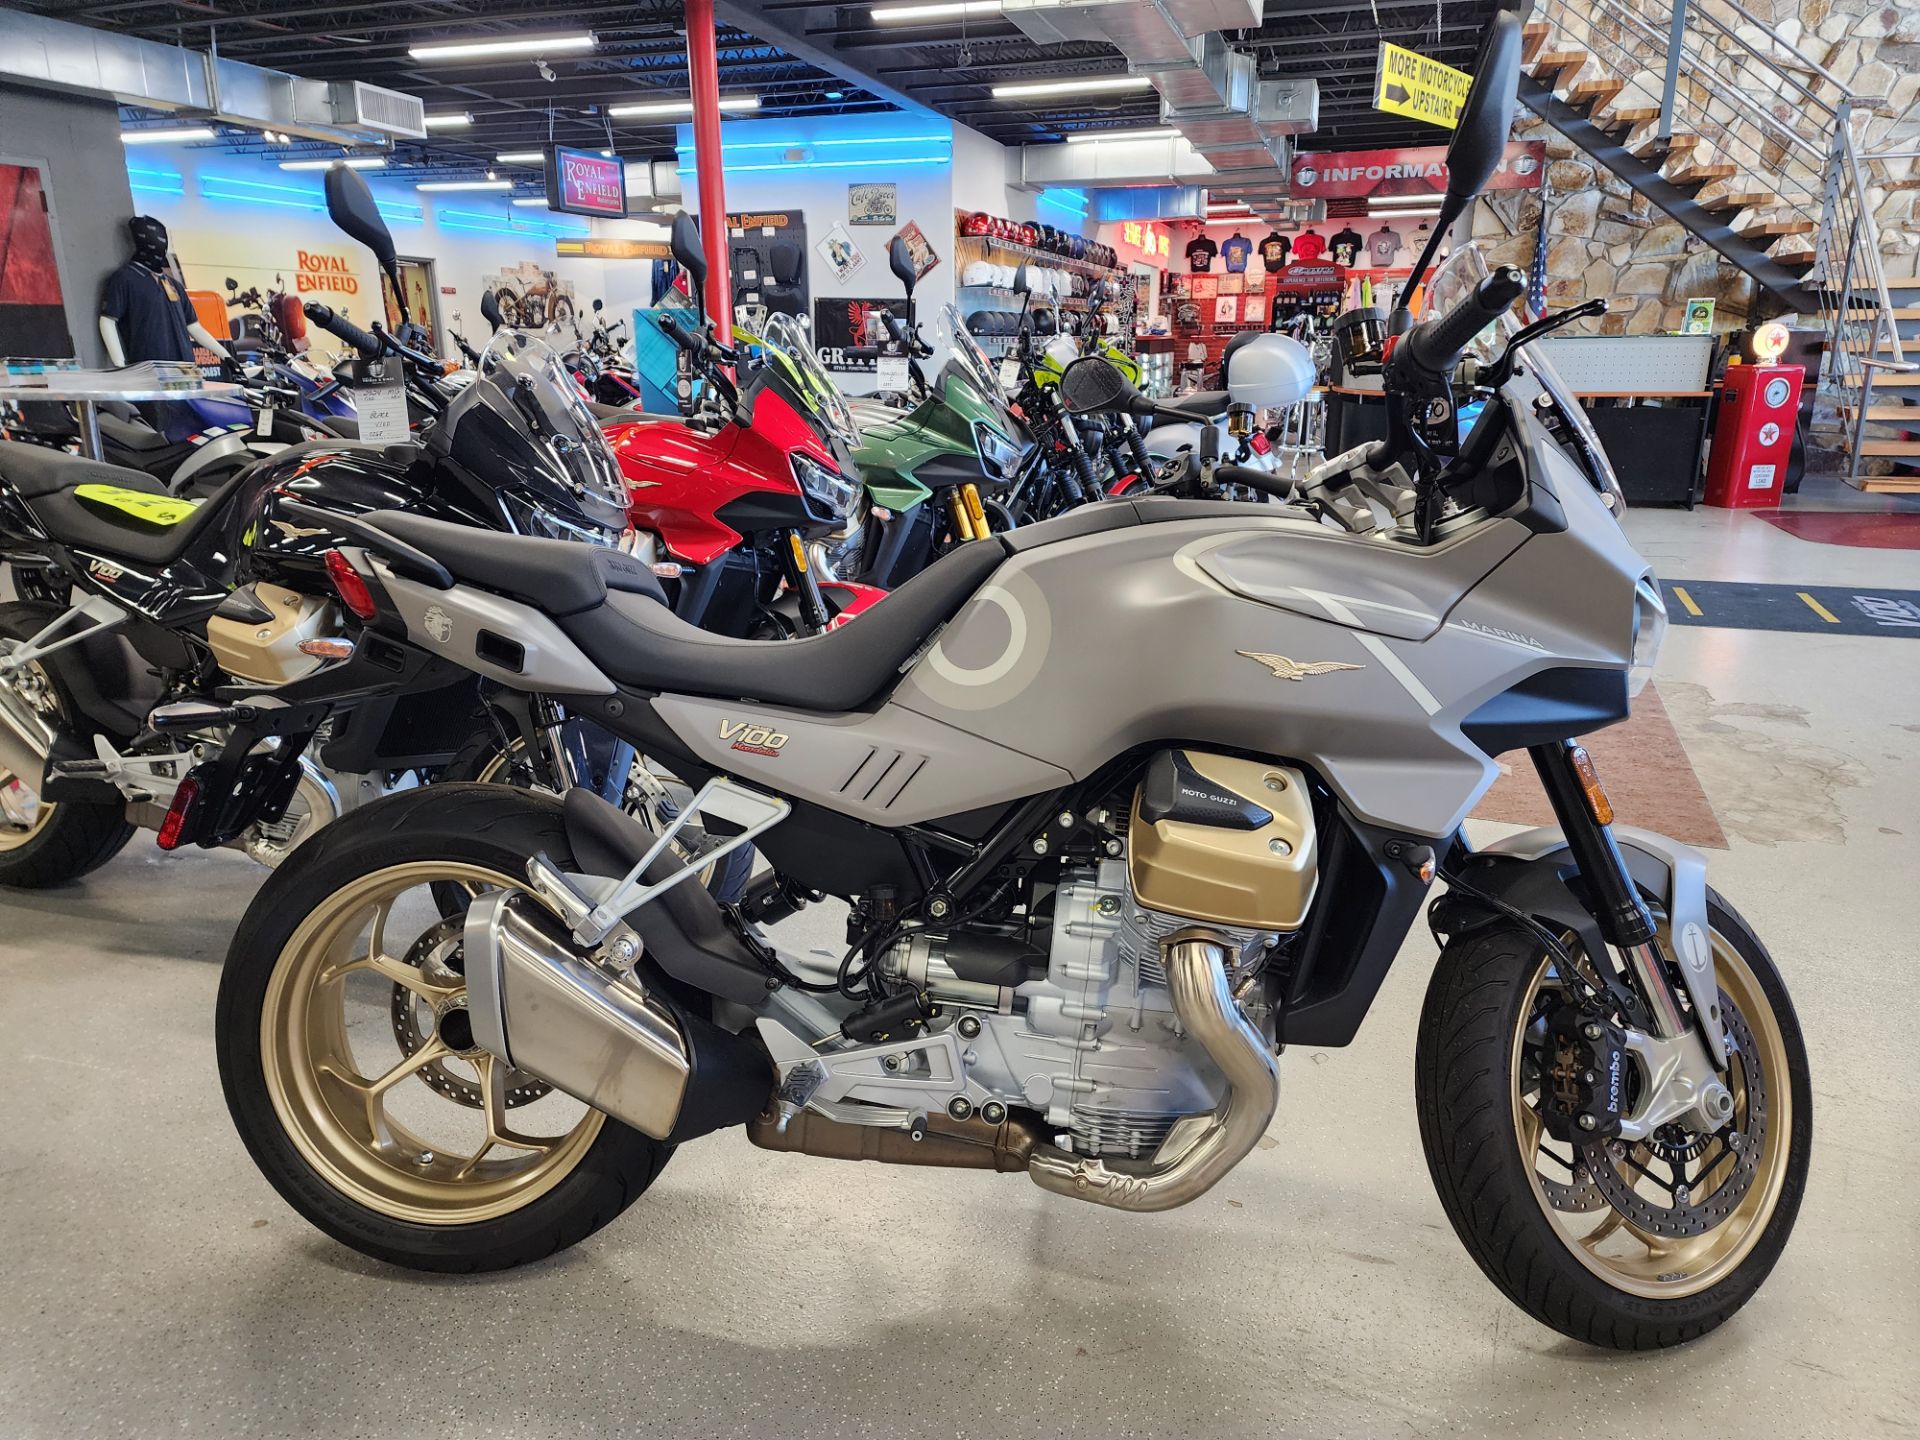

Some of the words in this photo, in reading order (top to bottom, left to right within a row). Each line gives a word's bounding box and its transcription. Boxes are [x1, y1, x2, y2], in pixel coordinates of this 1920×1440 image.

[1388, 50, 1417, 80] MORE
[1419, 61, 1471, 98] MOTORCYCLE
[1412, 87, 1453, 120] UPSTAIRS
[565, 160, 605, 189] ROYAL
[577, 180, 619, 200] ENFIELD
[741, 214, 789, 229] ENFIELD
[297, 249, 349, 272] ROYAL
[295, 273, 358, 294] ENFIELD
[89, 559, 124, 579] V100
[1461, 619, 1545, 649] MARINA
[719, 719, 790, 749] V100
[1181, 788, 1207, 799] MOTO
[1209, 794, 1237, 806] GUZZI
[1607, 1050, 1620, 1113] brembo
